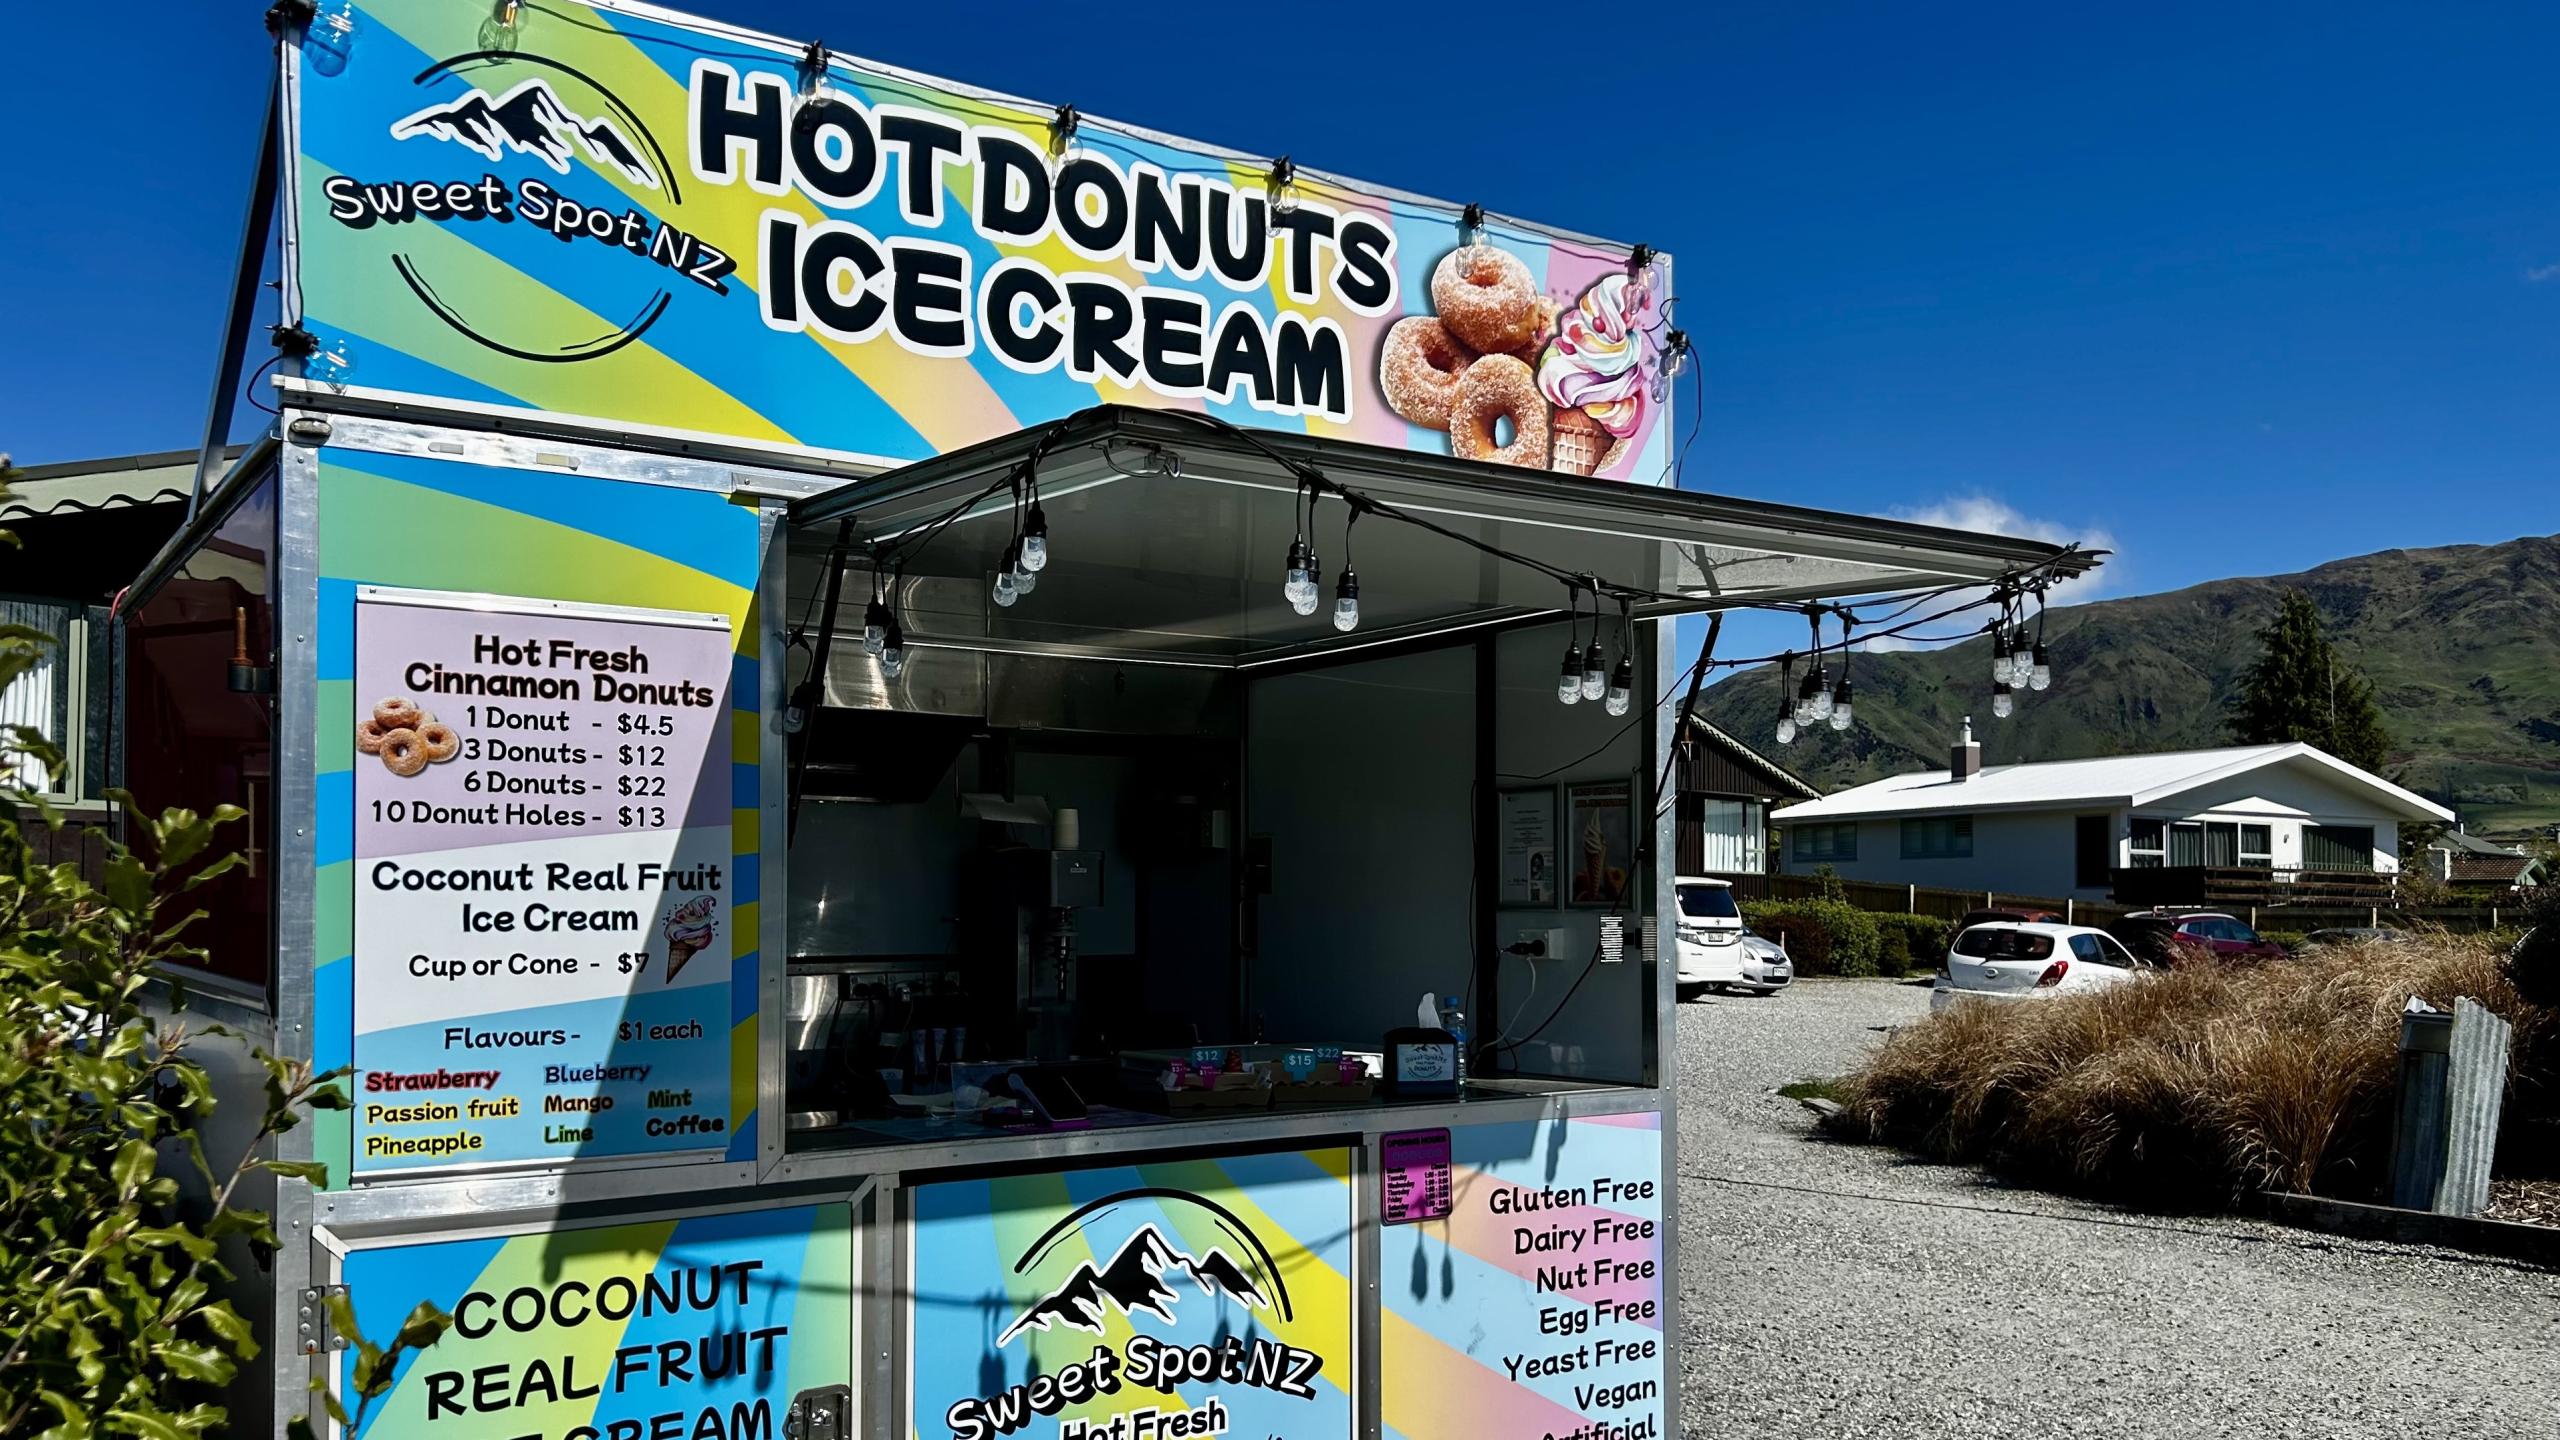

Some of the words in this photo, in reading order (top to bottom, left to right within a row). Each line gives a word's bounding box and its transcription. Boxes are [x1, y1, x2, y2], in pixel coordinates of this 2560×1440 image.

[700, 69, 963, 218] HOT
[978, 136, 1392, 308] DONUTS
[326, 174, 518, 225] Sweet
[521, 182, 653, 257] Spot
[652, 226, 736, 296] NZ
[768, 219, 967, 347] ICE
[987, 268, 1345, 415] CREAM
[474, 634, 541, 666] Hot
[549, 640, 649, 674] Fresh
[404, 662, 580, 701] Cinnamon
[593, 674, 714, 708] Donuts
[467, 706, 477, 728] 1
[486, 706, 570, 731] Donut
[617, 713, 674, 737] $4.5
[464, 737, 481, 761] 3
[487, 739, 587, 764] Donuts
[618, 744, 665, 767] $12
[464, 770, 481, 792] 6
[487, 771, 586, 796] Donuts
[618, 774, 666, 798] $22
[371, 799, 406, 823] 10
[412, 801, 499, 825] Donut
[505, 803, 586, 827] Holes
[618, 805, 665, 829] $13
[371, 861, 534, 892] Coconut
[545, 863, 630, 892] Real
[637, 863, 722, 892] Fruit
[462, 903, 515, 933] Ice
[523, 903, 639, 933] Cream
[408, 954, 467, 982] Cup
[472, 958, 503, 976] or
[507, 953, 579, 976] Cone
[617, 952, 650, 975] $7
[444, 1027, 566, 1050] Flavours
[619, 1019, 643, 1042] $1
[648, 1018, 703, 1040] each
[1196, 1050, 1218, 1062] $12
[1288, 1053, 1312, 1067] $15
[1317, 1047, 1339, 1059] $22
[366, 1067, 502, 1093] Strawberry
[544, 1064, 652, 1084] Blueberry
[367, 1104, 458, 1125] Passion
[468, 1097, 519, 1120] fruit
[544, 1094, 614, 1116] Mango
[647, 1088, 693, 1109] Mint
[544, 1126, 594, 1144] Lime
[646, 1114, 725, 1137] Coffee
[366, 1132, 482, 1157] Pineapple
[1489, 1185, 1587, 1215] Gluten
[1592, 1178, 1655, 1205] Free
[1514, 1223, 1587, 1254] Dairy
[1593, 1219, 1655, 1245] Free
[1536, 1265, 1588, 1293] Nut
[1594, 1259, 1656, 1286] Free
[454, 1260, 764, 1340] COCONUT
[1540, 1307, 1588, 1336] Egg
[1595, 1299, 1656, 1327] Free
[424, 1355, 600, 1421] REAL
[614, 1326, 788, 1394] FRUIT
[1502, 1343, 1588, 1382] Yeast
[1595, 1339, 1657, 1367] Free
[948, 1346, 1119, 1440] Sweet
[1126, 1336, 1246, 1392] Spot
[1247, 1343, 1322, 1400] NZ
[1574, 1379, 1657, 1411] Vegan
[1134, 1400, 1226, 1440] Fresh
[1542, 1413, 1657, 1440] ificial
